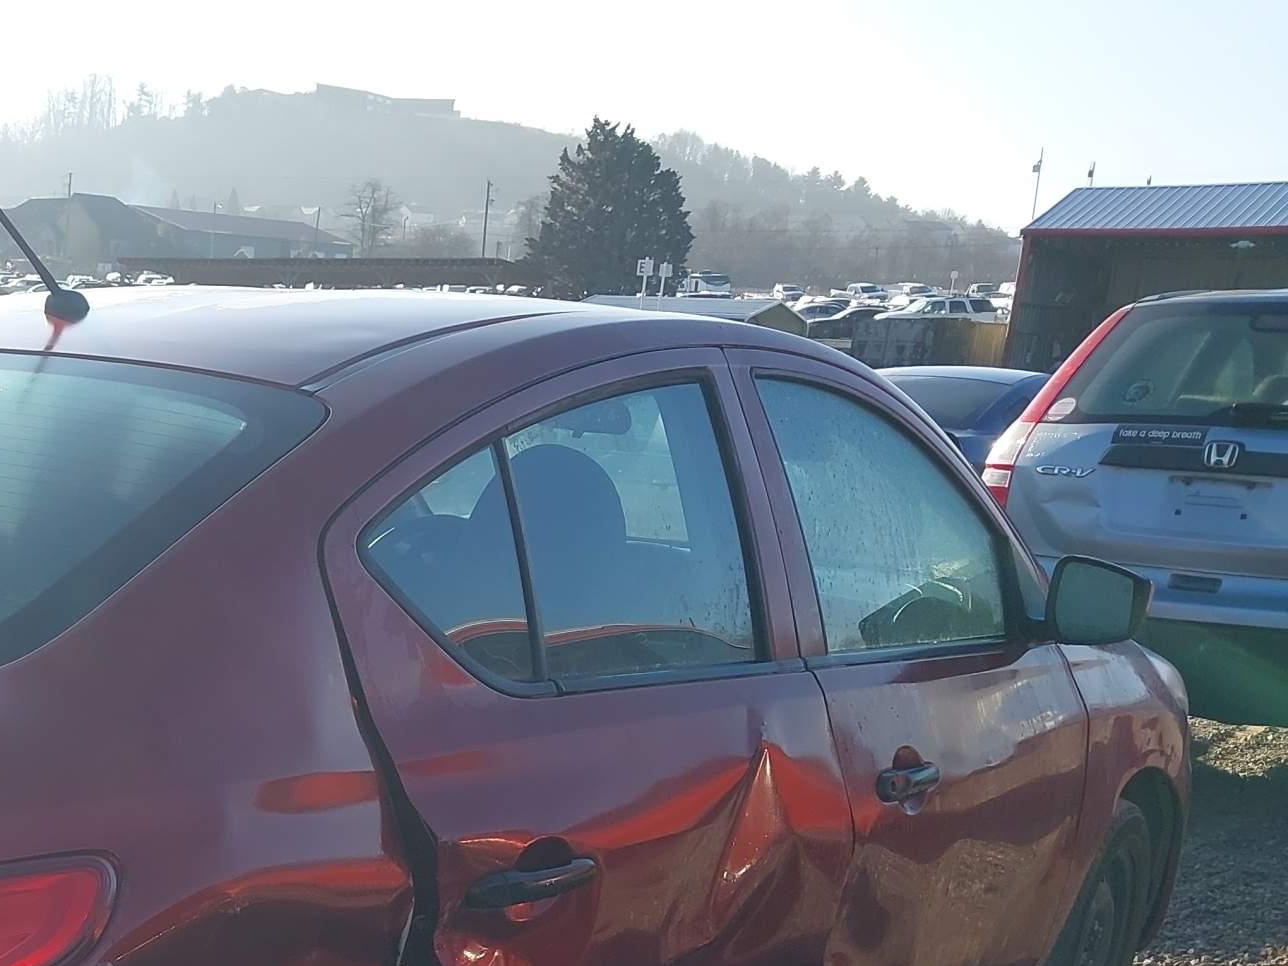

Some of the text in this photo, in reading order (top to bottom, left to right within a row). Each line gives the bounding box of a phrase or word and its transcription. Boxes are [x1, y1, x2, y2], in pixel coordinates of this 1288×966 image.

[1139, 430, 1146, 438] a
[1147, 429, 1170, 441] deep
[1171, 430, 1202, 440] breath
[1036, 465, 1096, 478] CR-V
